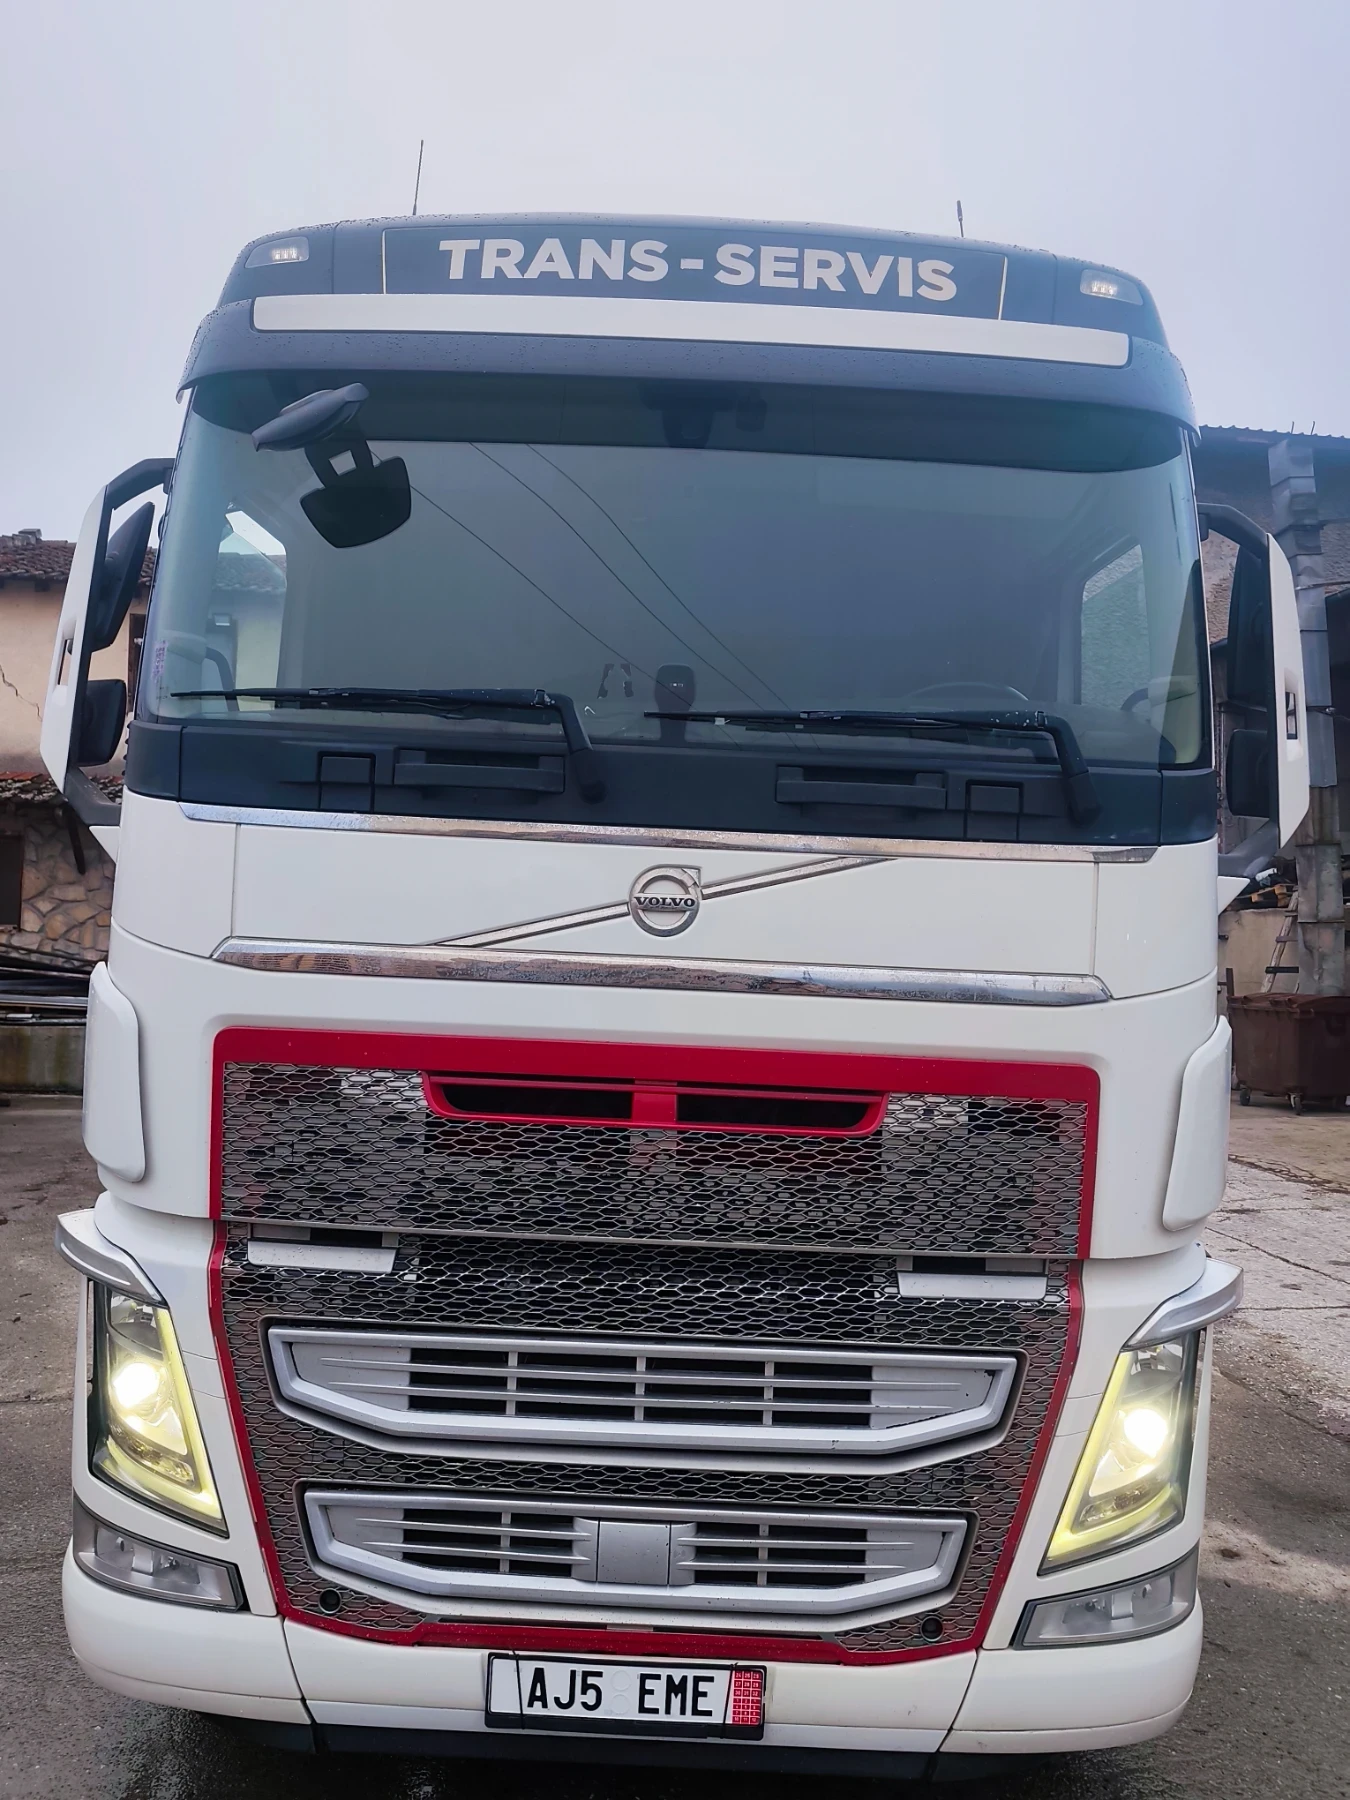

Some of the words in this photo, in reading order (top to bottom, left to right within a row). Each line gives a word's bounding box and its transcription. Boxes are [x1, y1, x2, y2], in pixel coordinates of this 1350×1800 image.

[438, 238, 669, 281] TRANS
[679, 258, 704, 270] -
[713, 243, 958, 302] SERVIS
[633, 896, 696, 908] VOLVO
[527, 1667, 604, 1711] AJ5
[638, 1672, 715, 1717] EME
